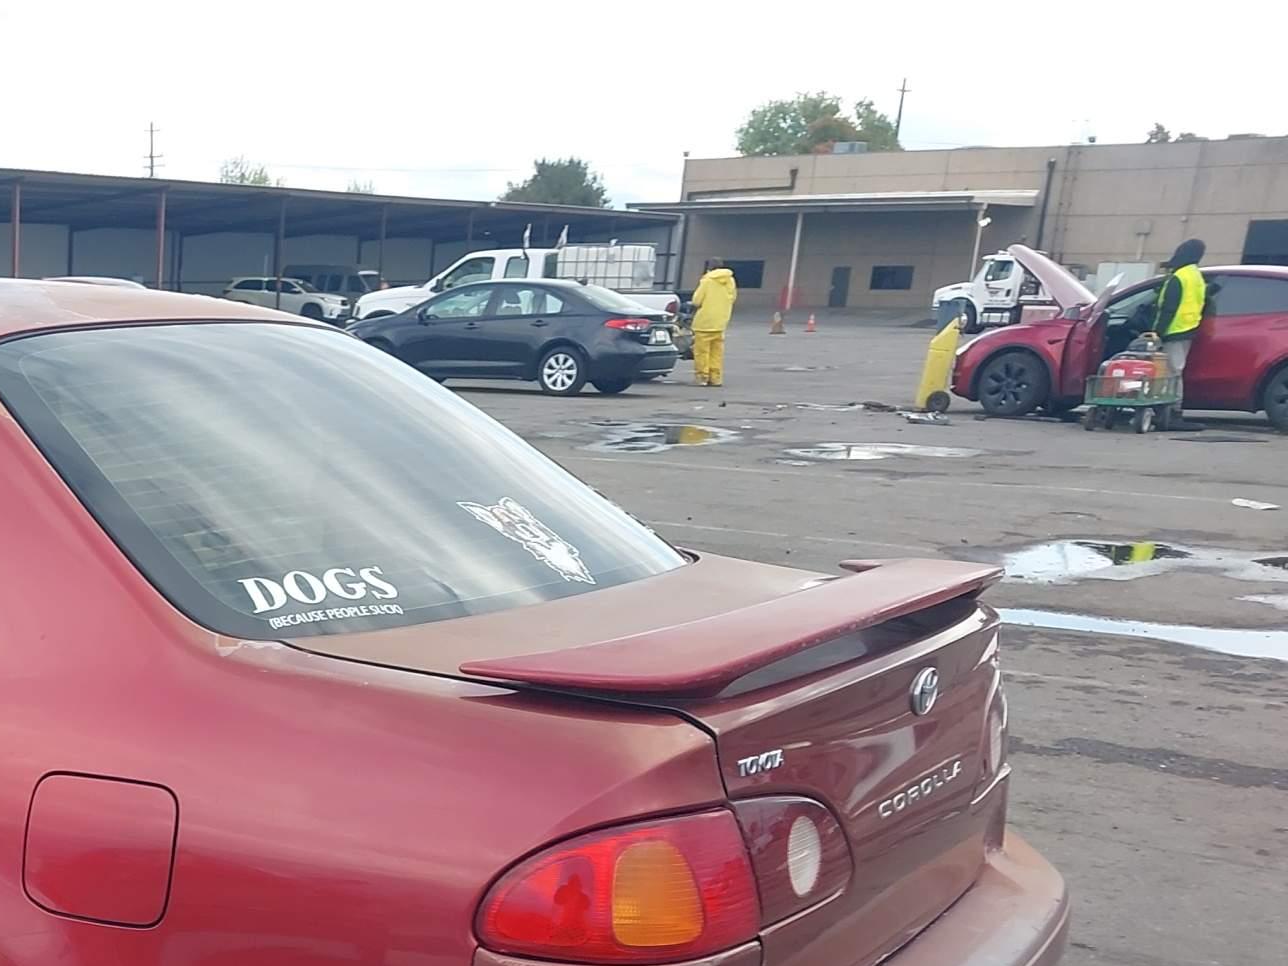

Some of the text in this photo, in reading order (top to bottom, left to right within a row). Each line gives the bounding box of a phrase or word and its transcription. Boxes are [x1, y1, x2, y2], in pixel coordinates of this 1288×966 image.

[237, 566, 399, 614] DOGS
[269, 609, 328, 629] (BECAUSE
[327, 605, 369, 619] PEOPLE
[878, 761, 961, 817] COROLLA
